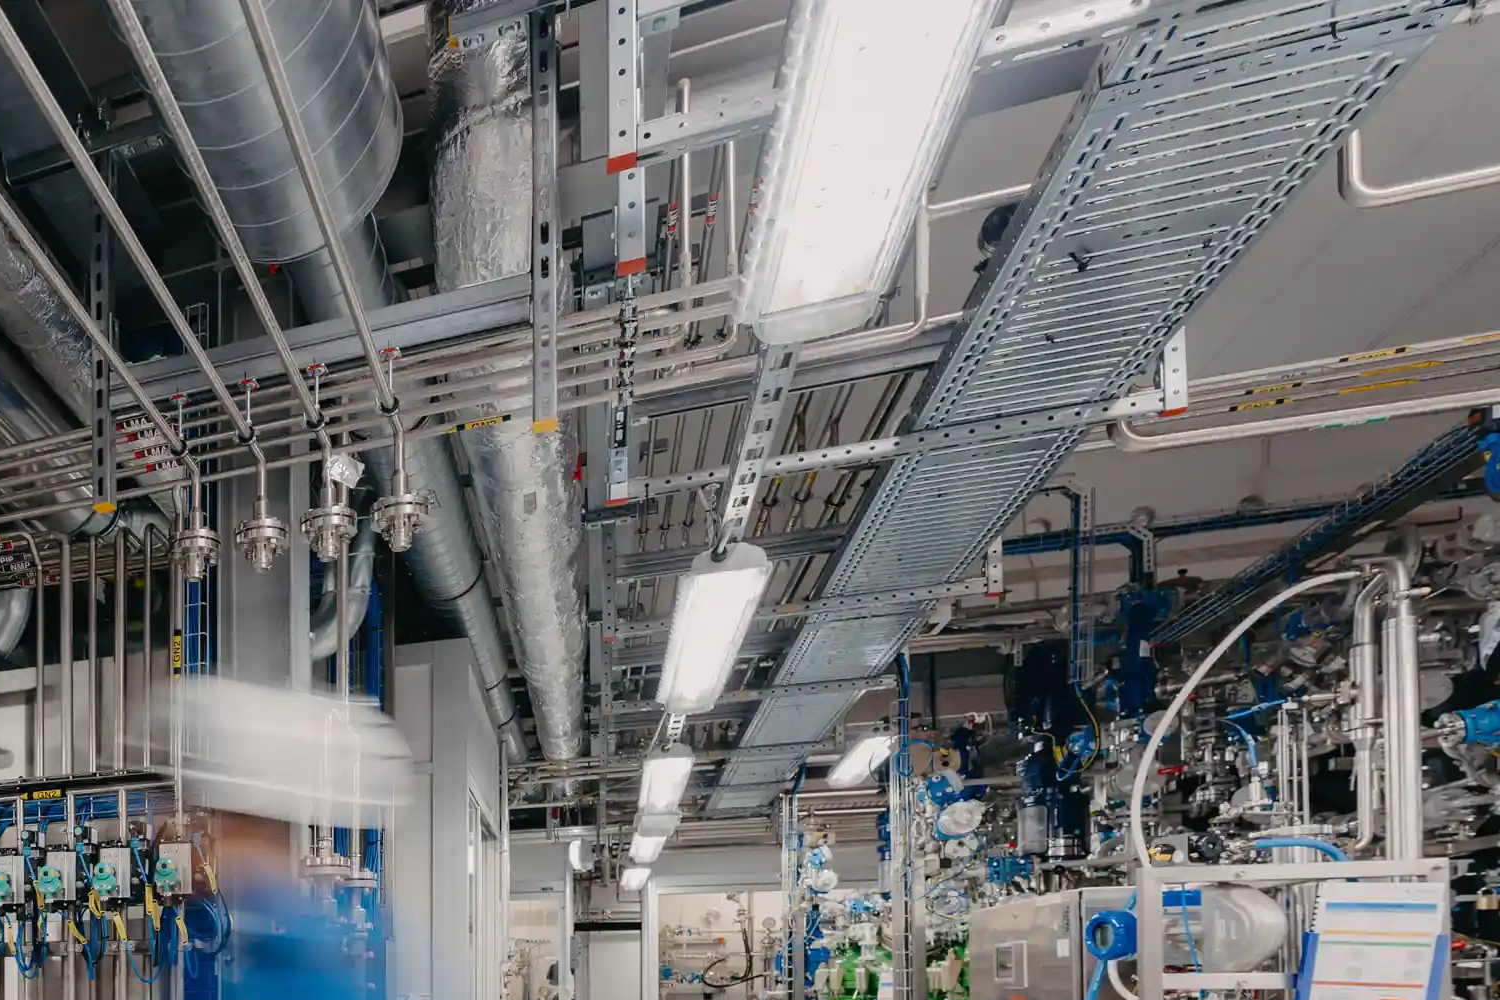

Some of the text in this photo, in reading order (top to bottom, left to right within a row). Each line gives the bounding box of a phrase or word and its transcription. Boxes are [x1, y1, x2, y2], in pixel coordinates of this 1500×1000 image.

[123, 417, 148, 429] LMA
[155, 459, 179, 471] LMA
[0, 555, 14, 565] PIP
[10, 561, 30, 572] NMP
[173, 640, 181, 663] GN2
[36, 790, 57, 799] GN2
